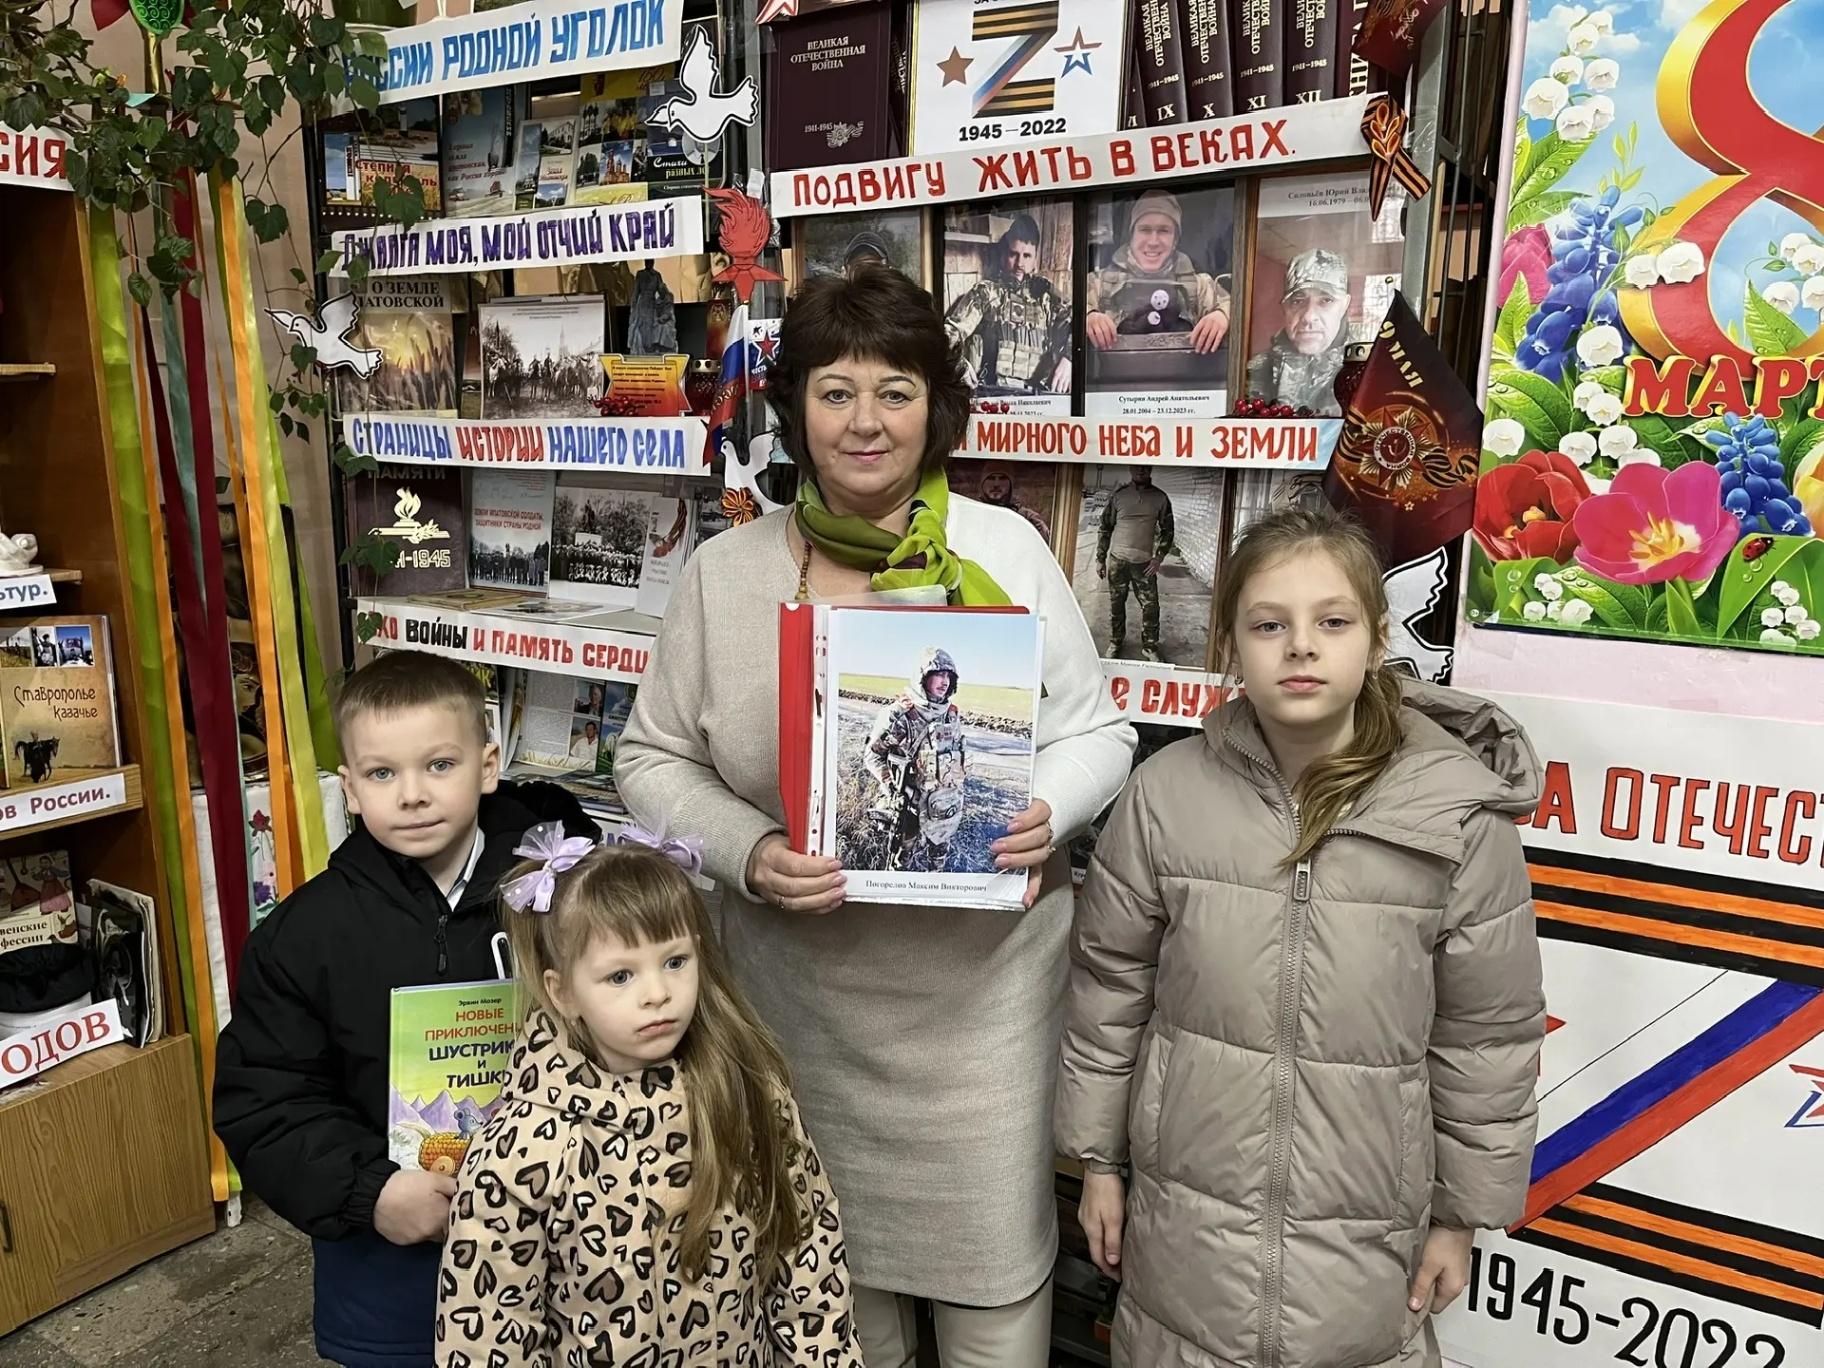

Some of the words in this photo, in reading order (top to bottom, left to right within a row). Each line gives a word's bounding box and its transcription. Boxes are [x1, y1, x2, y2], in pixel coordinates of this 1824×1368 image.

[1141, 3, 1154, 52] ВЕЛИКАЯ
[1160, 2, 1172, 41] ВОЙНА
[442, 12, 542, 82] РОДНОЙ
[550, 0, 665, 64] УГОЛОК
[790, 45, 866, 64] ОТЕЧЕСТВЕННАЯ
[807, 36, 849, 51] ВЕЛИКАЯ
[811, 59, 844, 72] ВОЙНА
[1157, 103, 1176, 122] IX
[1203, 102, 1216, 119] X
[1247, 94, 1267, 110] XI
[793, 160, 947, 209] ПОДВИГУ
[971, 145, 1093, 193] ЖИТЬ
[1109, 140, 1136, 178] В
[1150, 118, 1297, 173] ВЕКАХ.
[425, 225, 479, 267] МОЯ,
[481, 217, 532, 263] МОЙ
[537, 208, 602, 260] ОТЧИЙ
[609, 202, 675, 253] КРАЙ
[386, 281, 440, 295] ЗЕМЛЕ
[353, 417, 452, 460] СТРАНИЦЫ
[455, 425, 545, 462] ИСТОРИИ
[977, 422, 1088, 455] МИРНОГО
[1176, 425, 1194, 459] И
[1211, 425, 1318, 462] ЗЕМЛИ
[405, 616, 468, 650] ВОЙНЫ
[473, 627, 485, 652] И
[491, 630, 574, 664] ПАМЯТЬ
[14, 685, 96, 707] Ставрополье
[30, 787, 111, 815] России.
[1512, 761, 1578, 834] А
[1600, 766, 1824, 869] ОТЕЧЕС
[455, 1008, 504, 1023] НОВЫЕ
